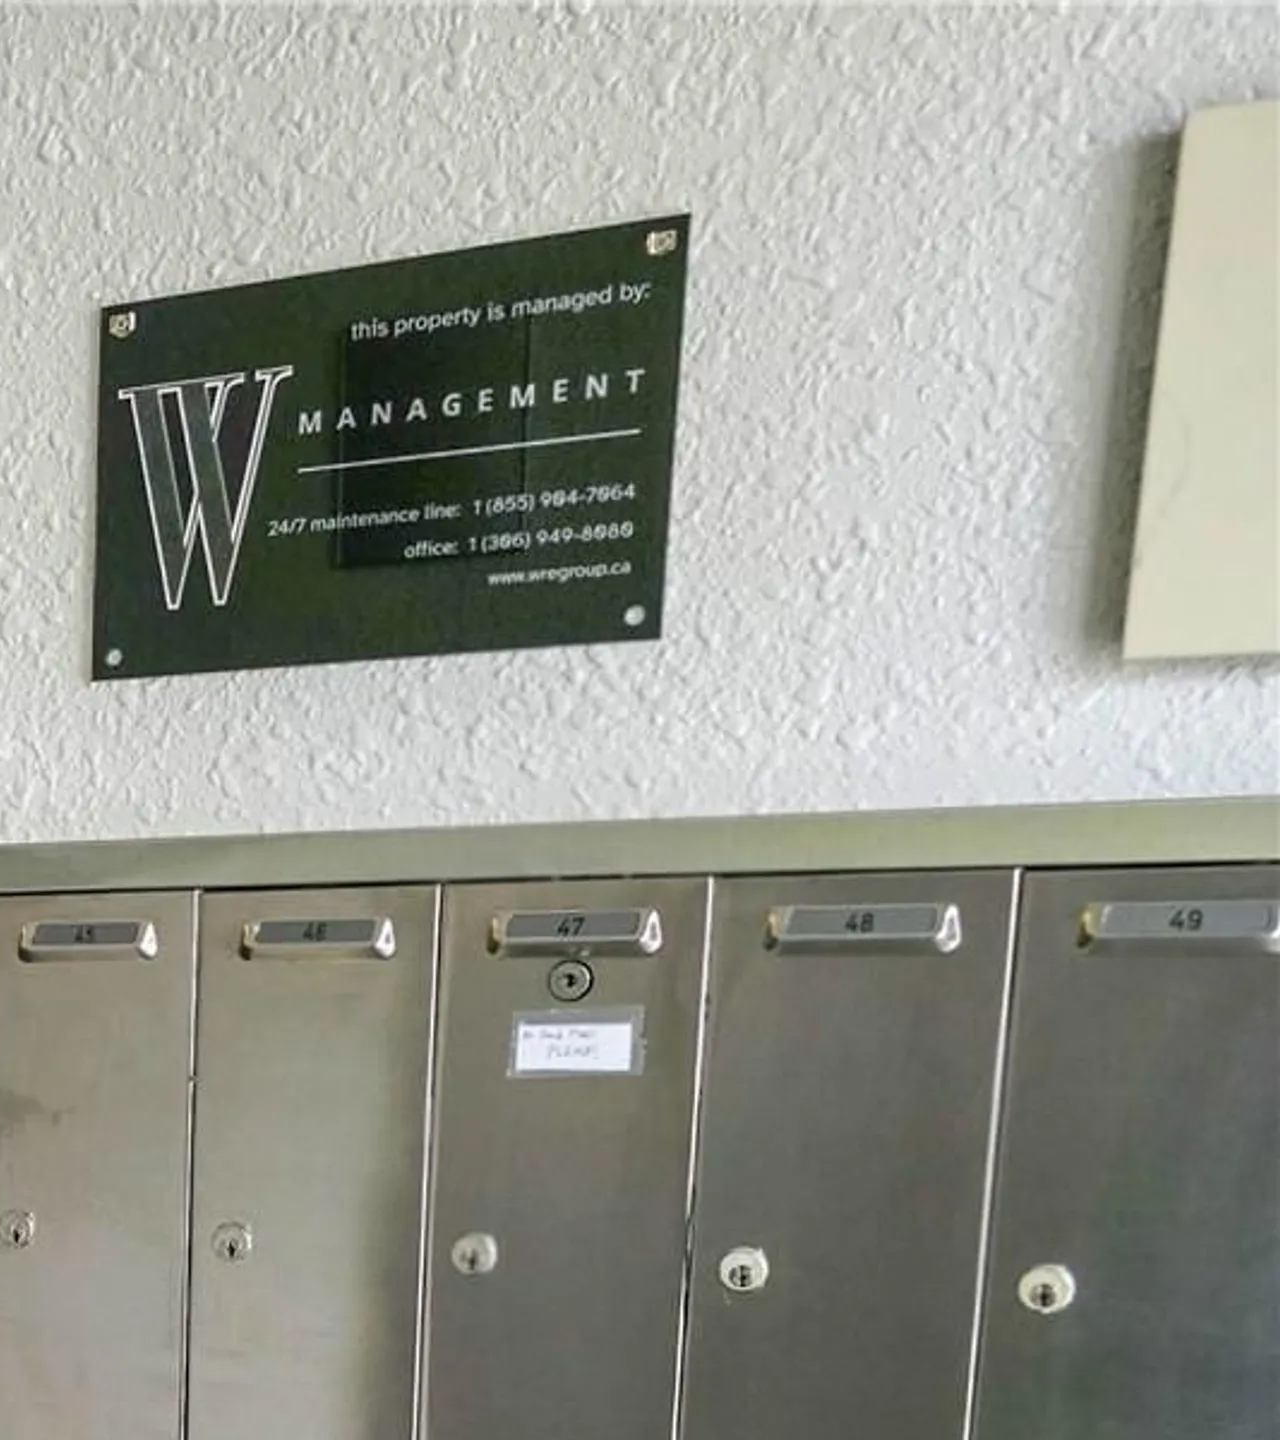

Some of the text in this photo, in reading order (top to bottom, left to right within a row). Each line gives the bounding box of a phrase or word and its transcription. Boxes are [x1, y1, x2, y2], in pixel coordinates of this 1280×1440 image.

[350, 281, 651, 341] this property is managed by:
[297, 368, 646, 435] MANAGEMENT
[267, 518, 307, 537] 24/7
[310, 508, 420, 533] maintenance
[424, 501, 462, 521] line:
[486, 493, 535, 518] (855)
[403, 539, 458, 559] office:
[557, 916, 585, 937] 47
[845, 911, 874, 933] 48
[1168, 908, 1204, 932] 49
